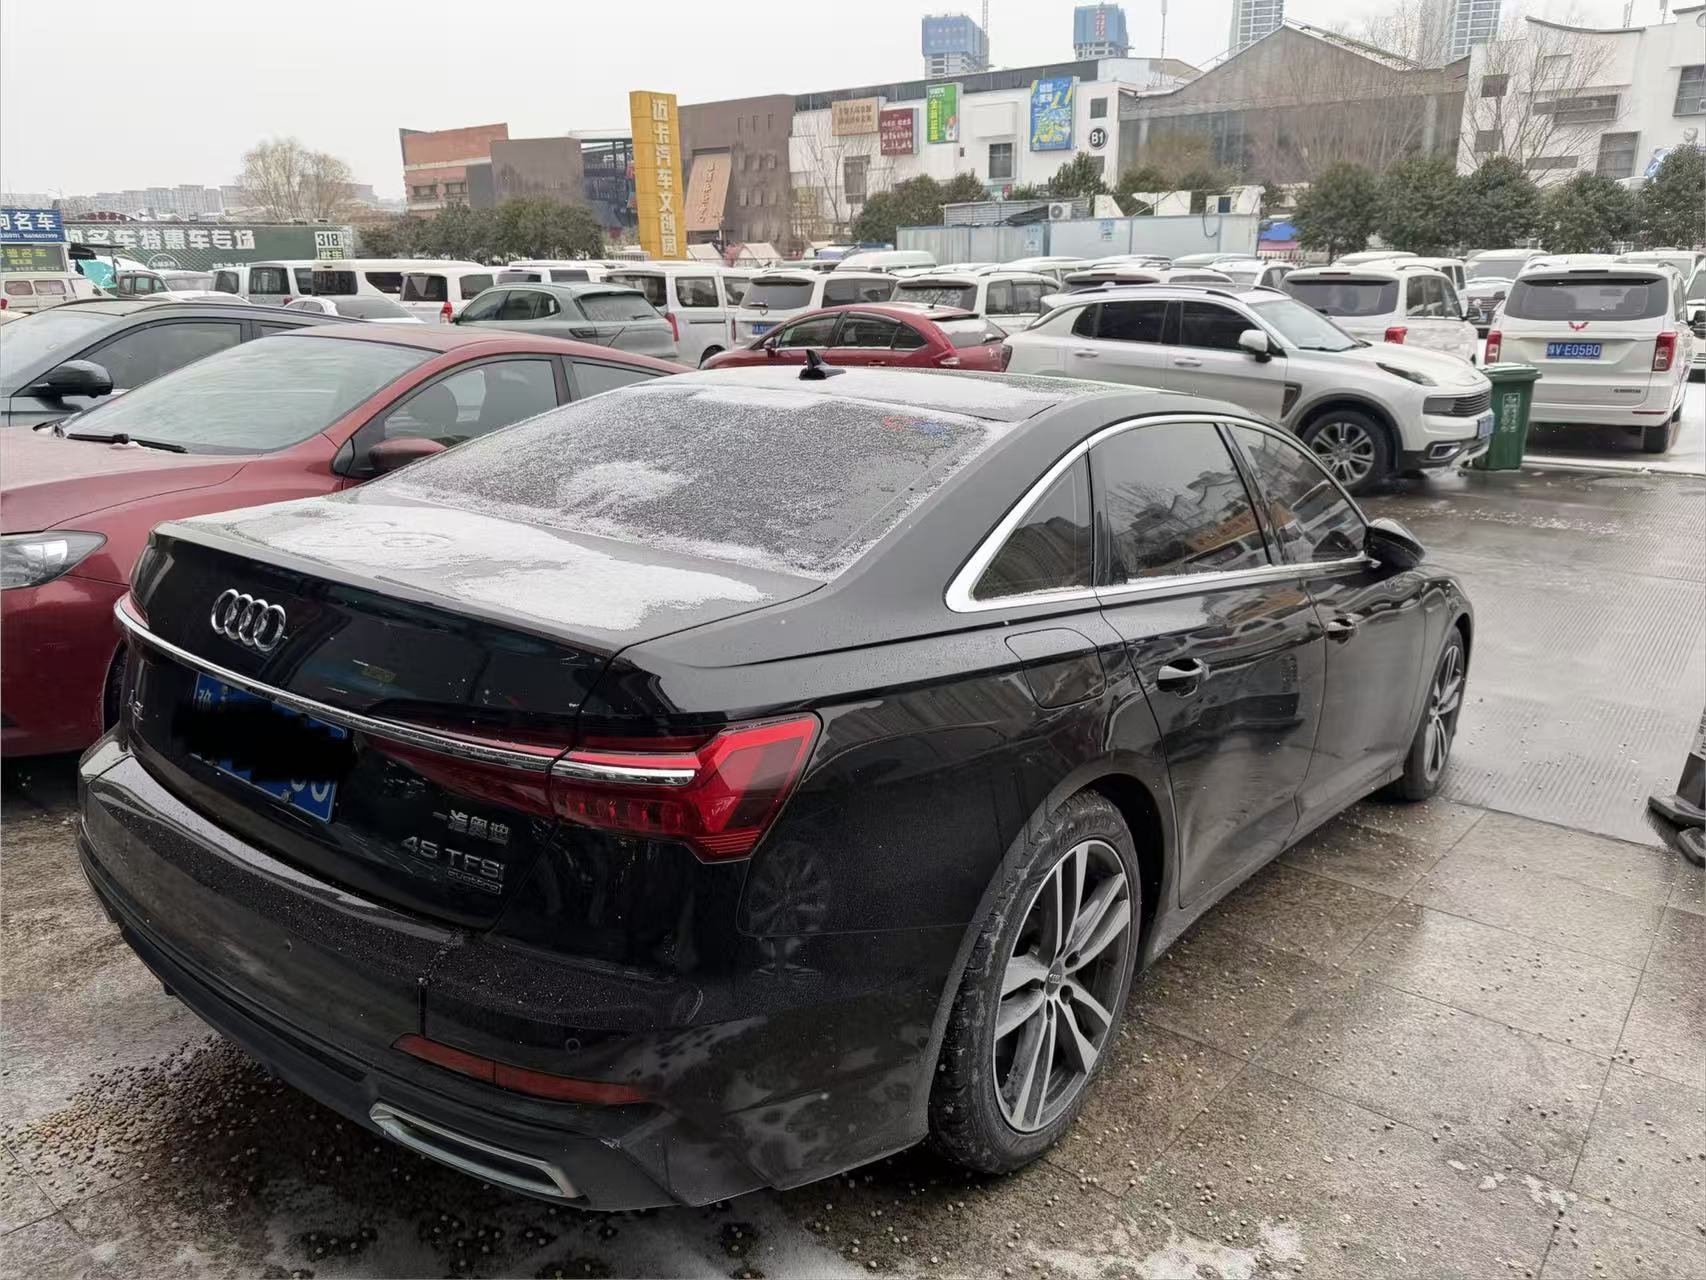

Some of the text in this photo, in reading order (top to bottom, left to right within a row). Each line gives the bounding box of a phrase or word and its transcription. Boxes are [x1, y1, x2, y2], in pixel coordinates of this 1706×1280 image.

[317, 233, 339, 246] 318
[400, 835, 505, 881] 45 TFSI
